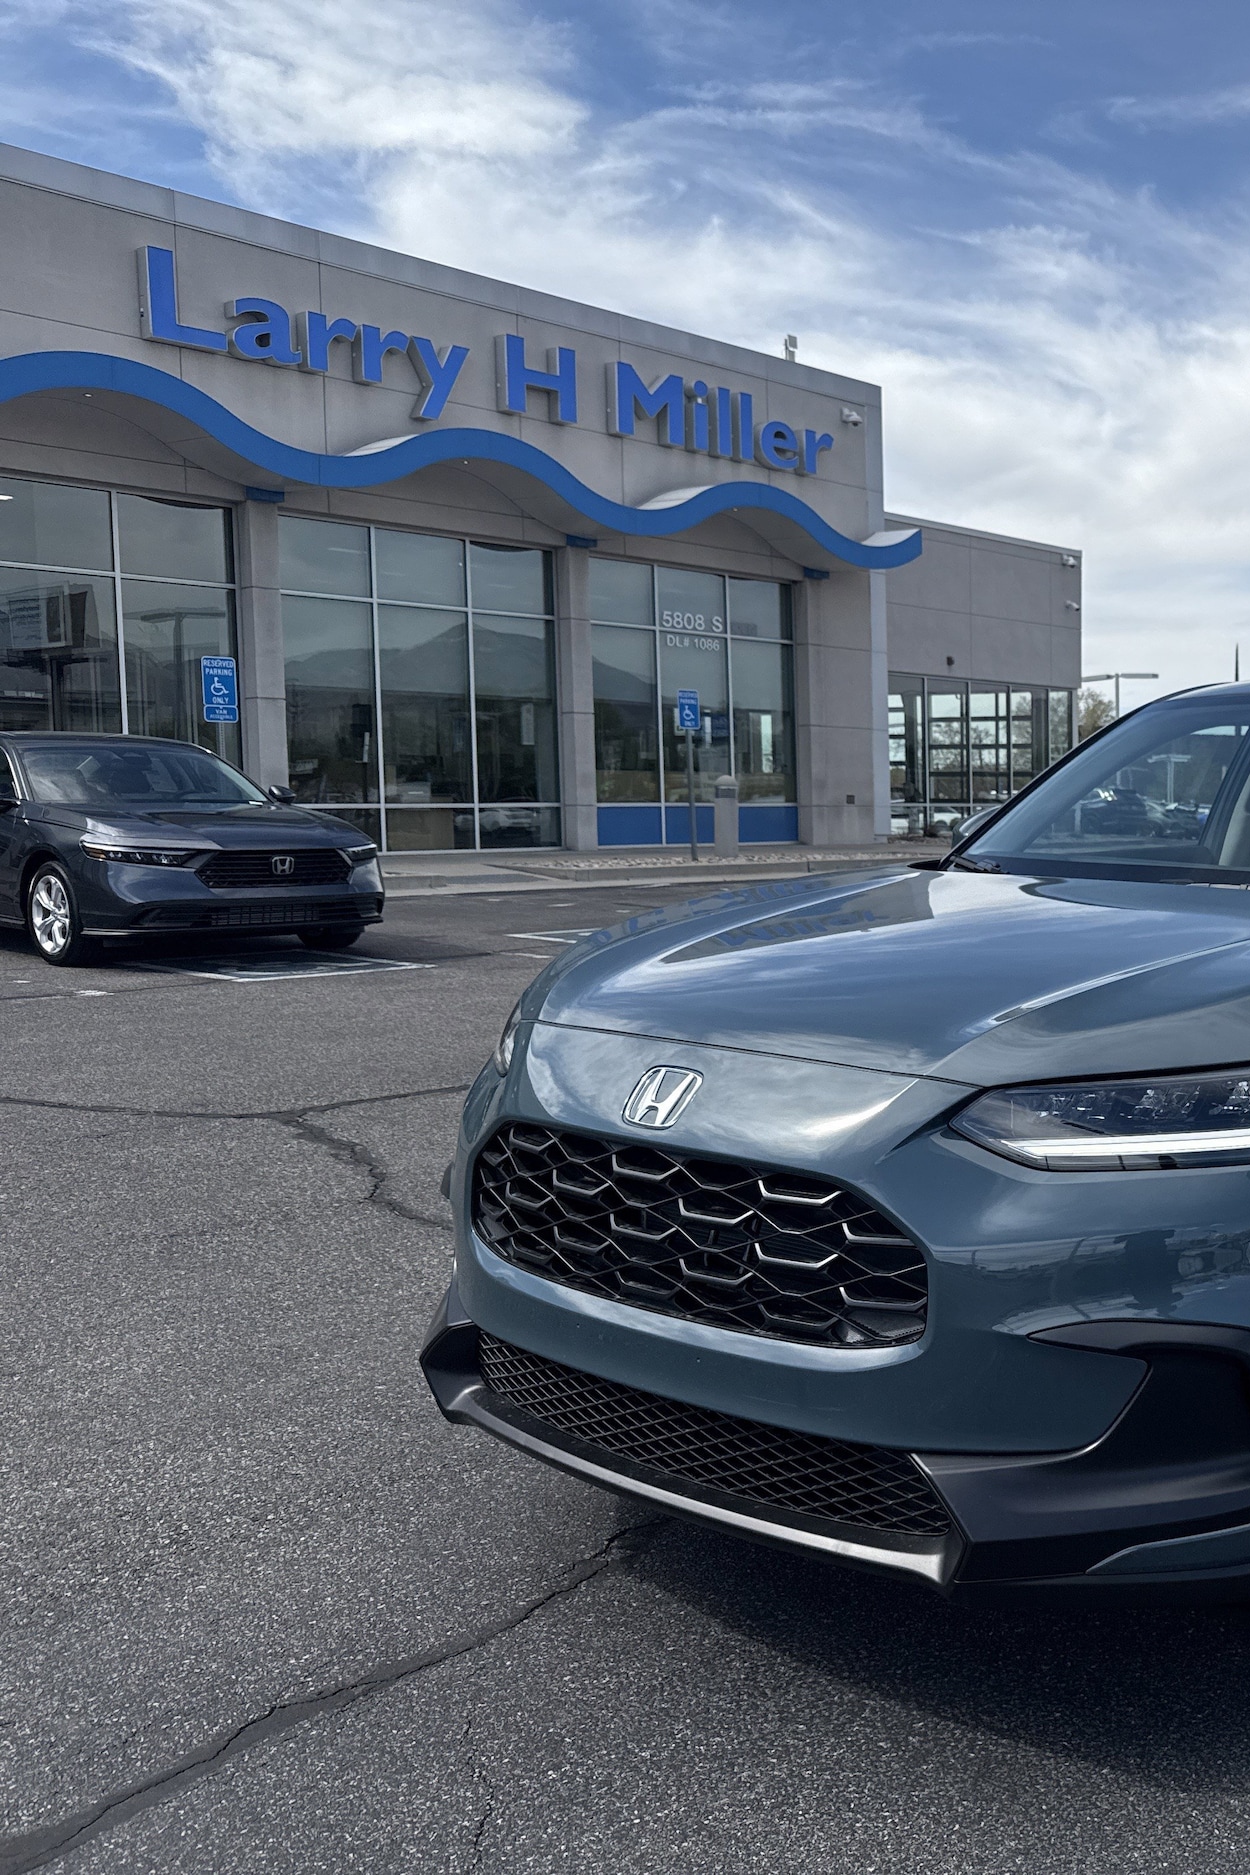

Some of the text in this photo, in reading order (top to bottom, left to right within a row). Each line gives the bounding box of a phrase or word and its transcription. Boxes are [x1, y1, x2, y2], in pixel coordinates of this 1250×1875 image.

[138, 245, 834, 475] Larry H Miller
[662, 611, 723, 632] 5808 S
[667, 634, 720, 651] DL# 1086
[203, 659, 233, 668] RESERVED
[205, 668, 232, 676] PARKING
[212, 696, 229, 704] ONLY
